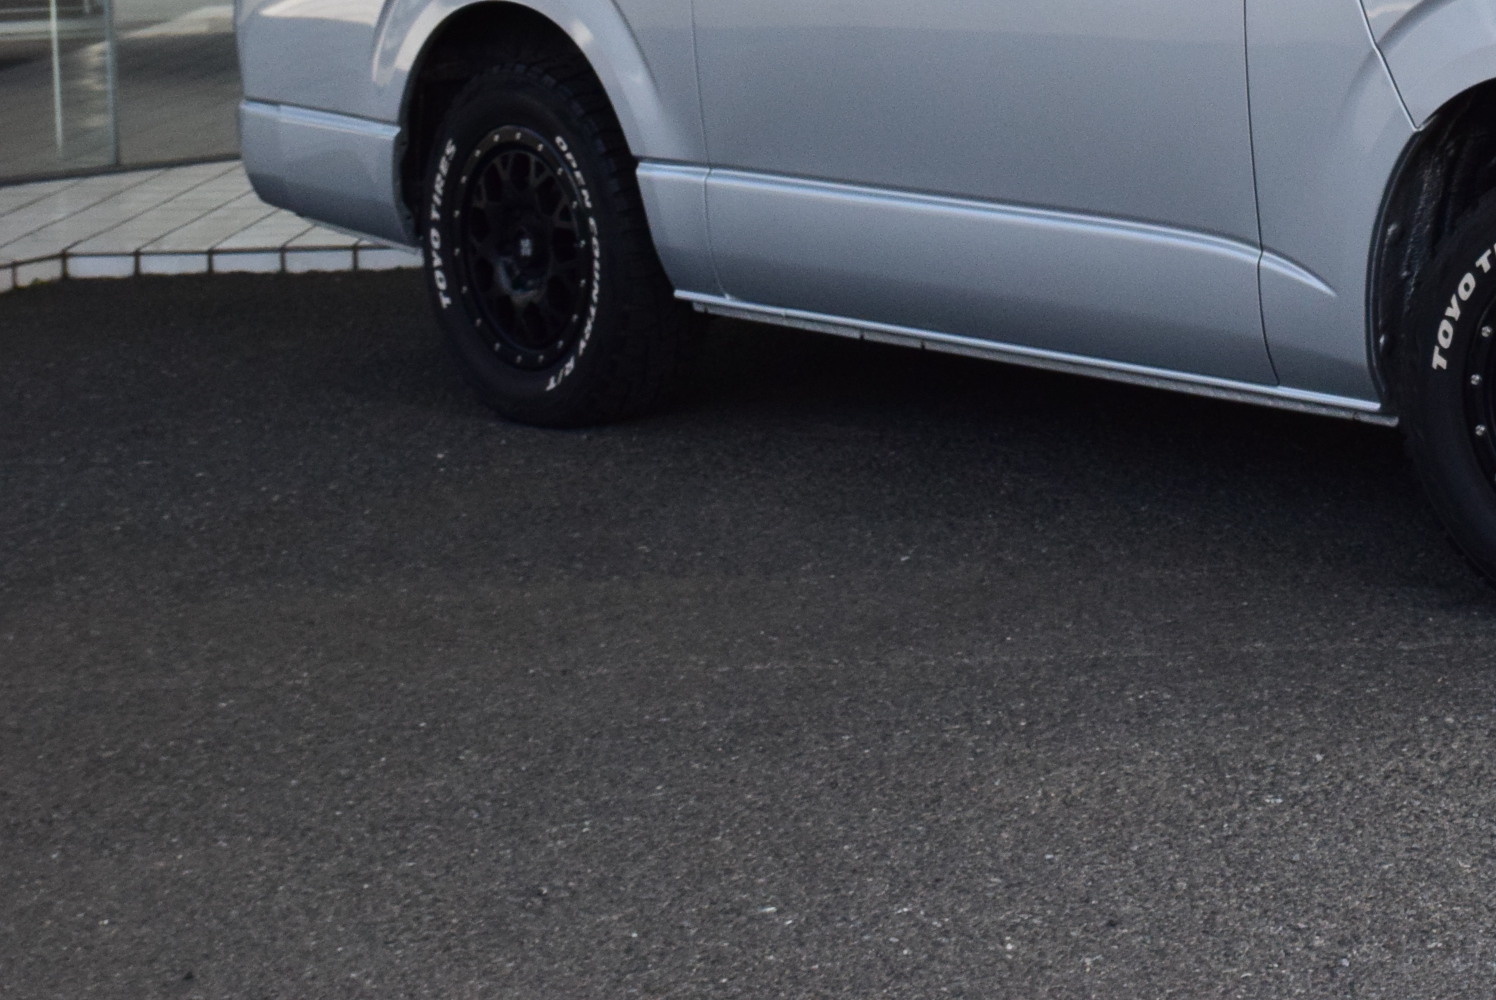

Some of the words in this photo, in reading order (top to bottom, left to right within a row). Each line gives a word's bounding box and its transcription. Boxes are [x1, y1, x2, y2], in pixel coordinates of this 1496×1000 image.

[430, 139, 456, 221] TIRES
[555, 135, 593, 208] OPEN
[430, 227, 452, 309] TOYO
[578, 217, 600, 355] COUNTRY
[1431, 271, 1476, 371] TOYO
[546, 356, 576, 391] R/T
